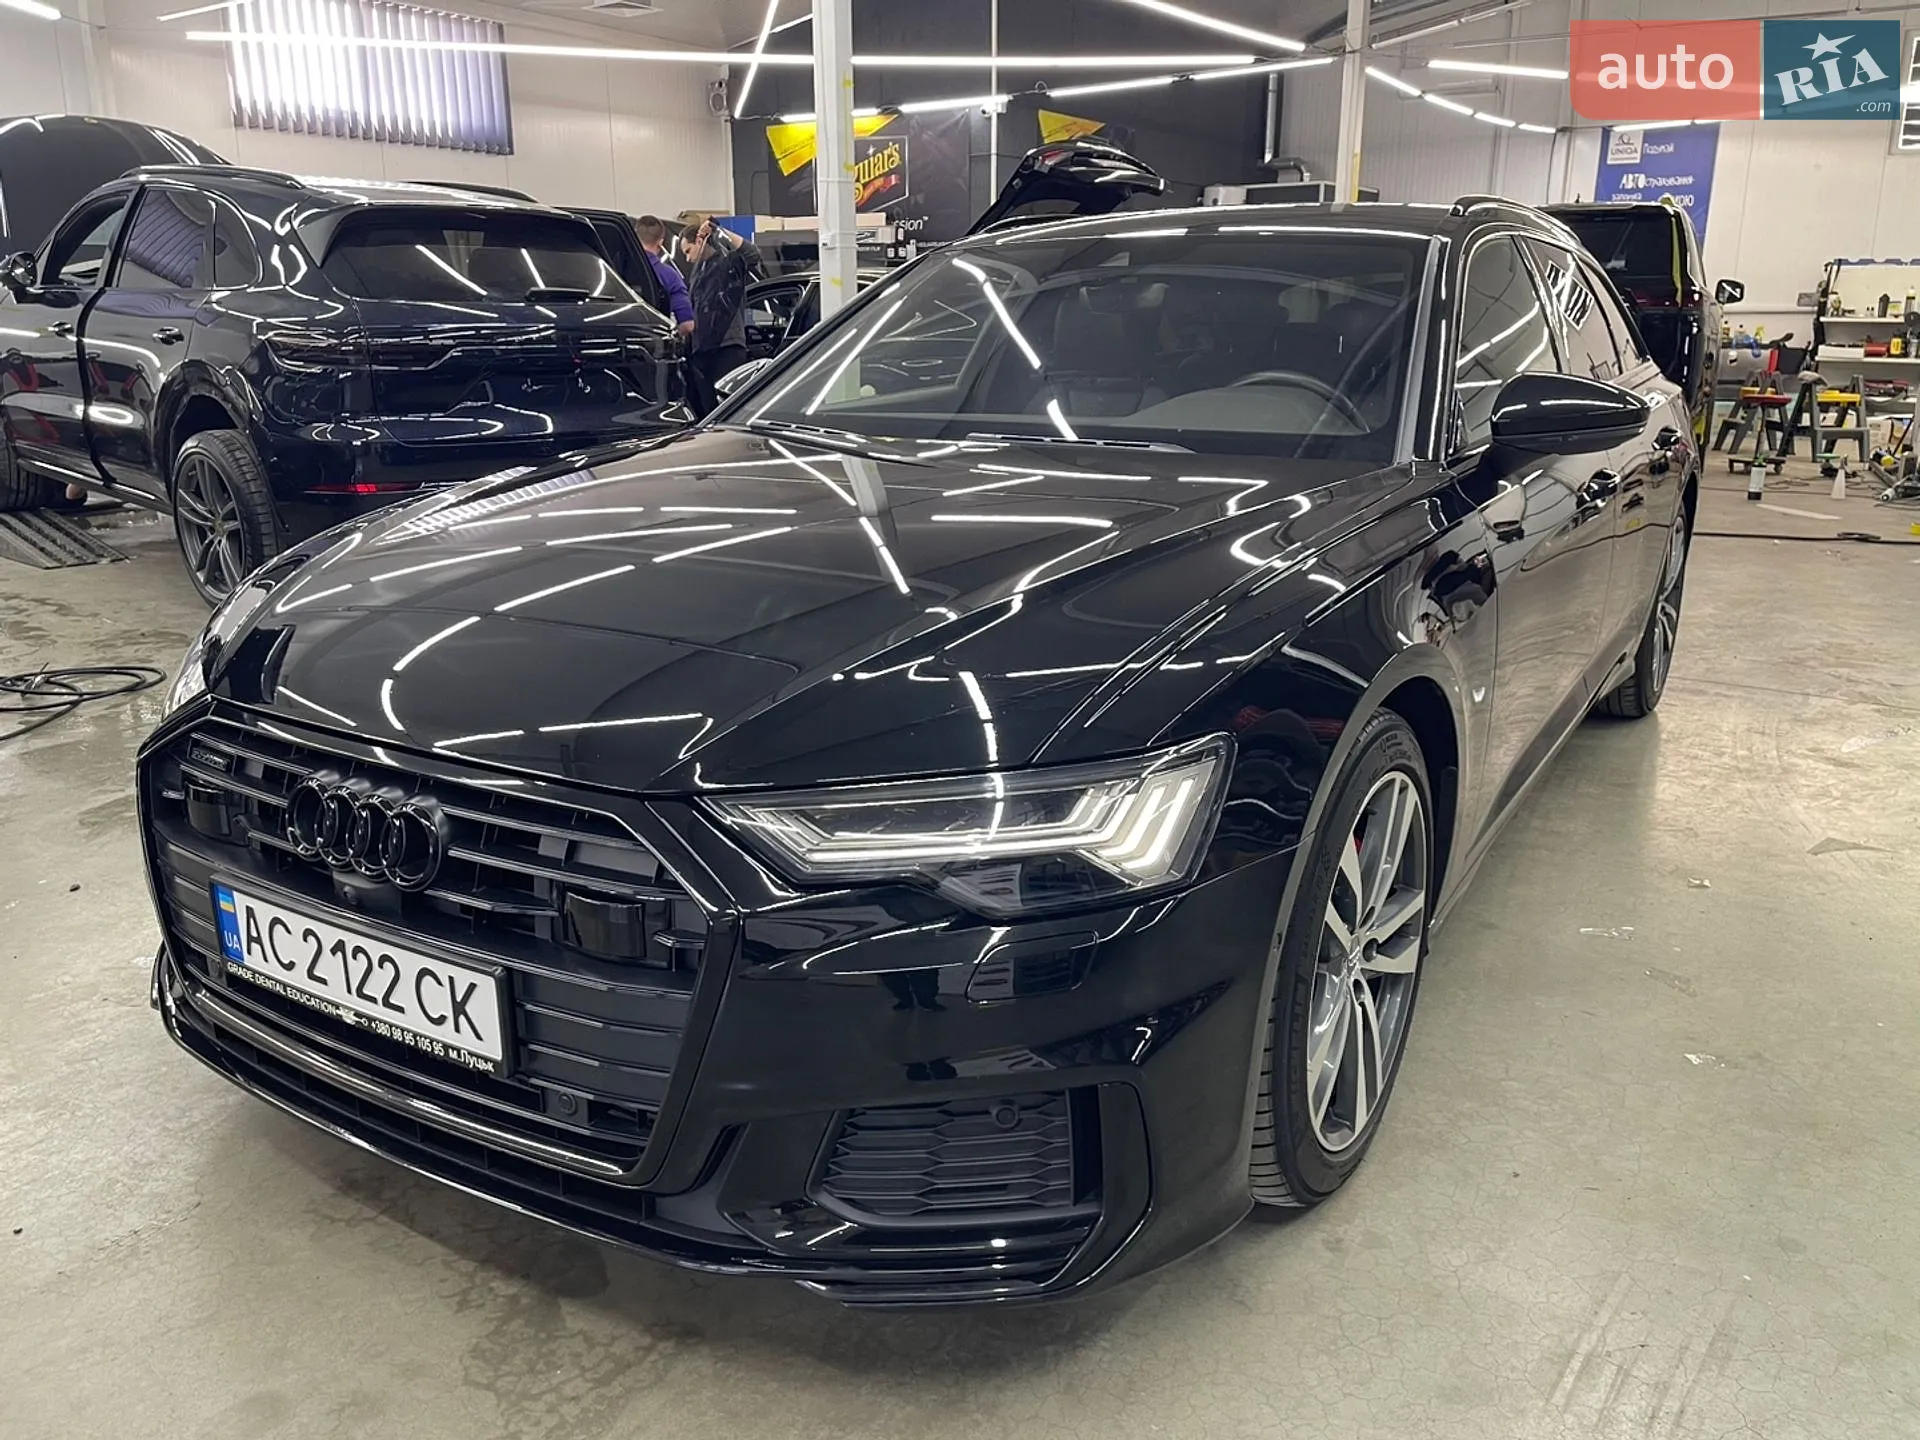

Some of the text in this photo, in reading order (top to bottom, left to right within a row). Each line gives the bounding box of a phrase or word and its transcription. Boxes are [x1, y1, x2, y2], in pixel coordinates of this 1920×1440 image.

[225, 931, 241, 951] UA
[227, 961, 336, 1015] GRADE DENTAL EDUCATION
[245, 904, 484, 1042] AC 2122 CK
[371, 1020, 391, 1037] +380
[404, 1030, 415, 1046] 95
[416, 1035, 432, 1052] 105
[432, 1040, 445, 1057] 95
